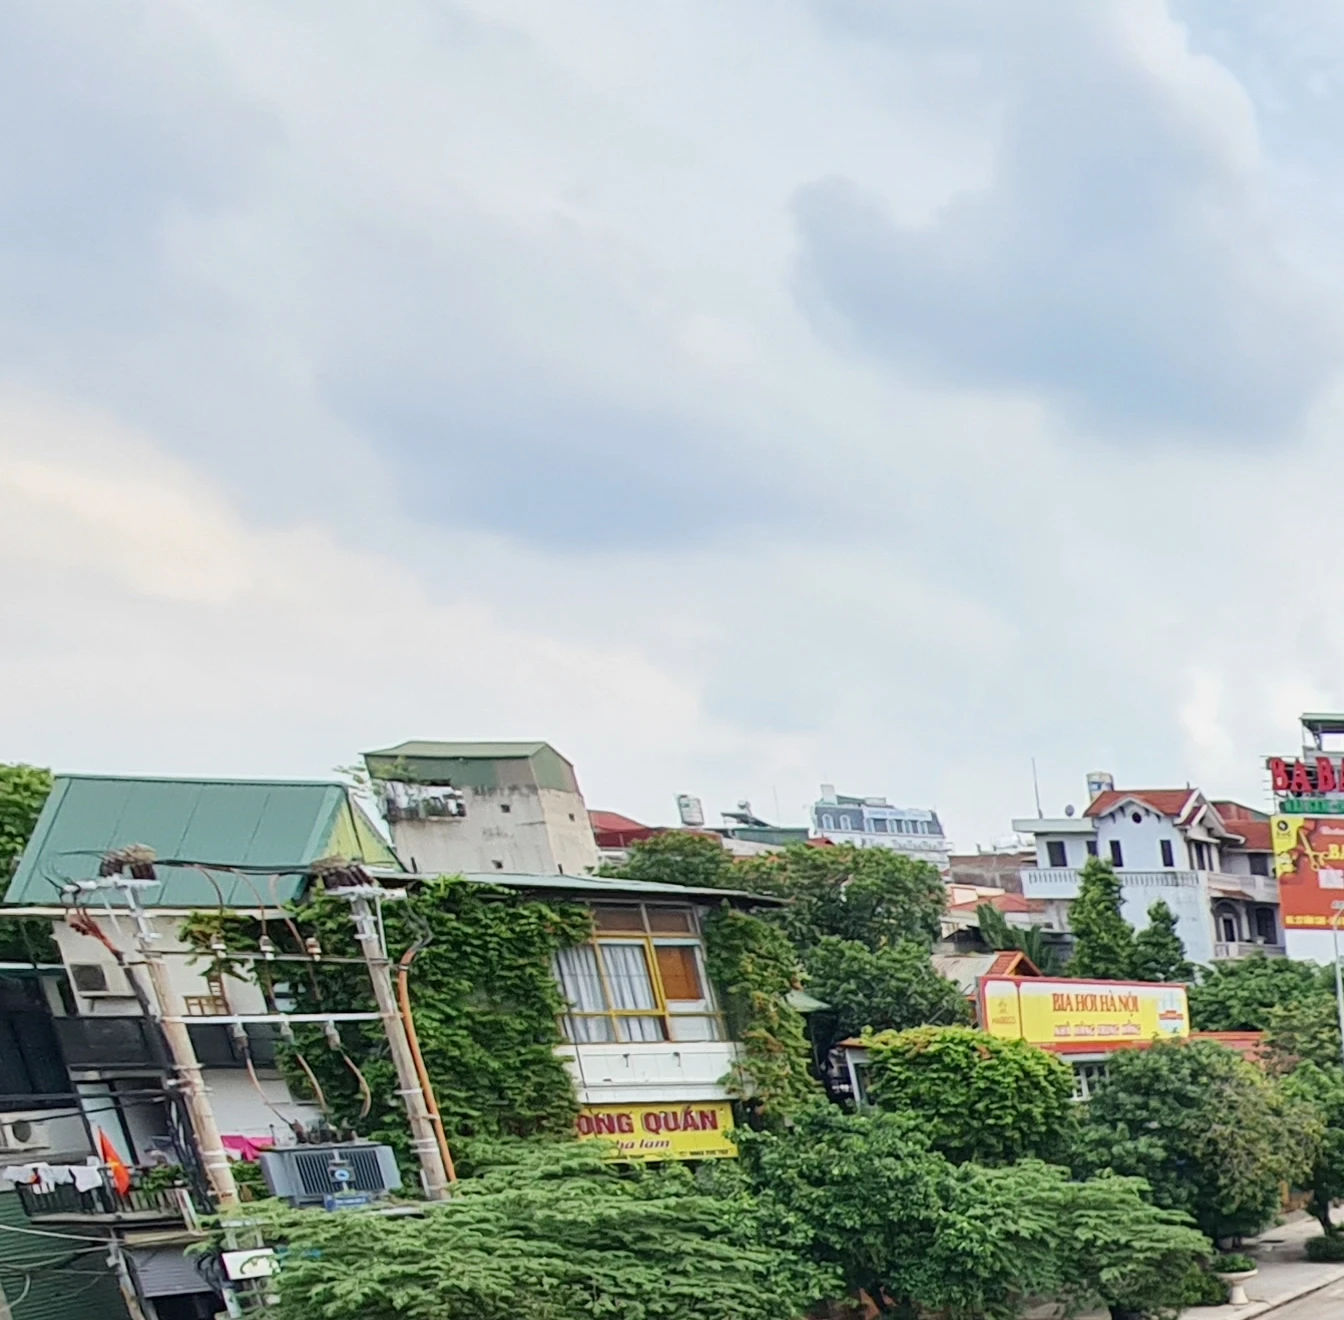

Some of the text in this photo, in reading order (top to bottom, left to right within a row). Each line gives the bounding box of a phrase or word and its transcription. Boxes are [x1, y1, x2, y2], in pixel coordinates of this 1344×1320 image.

[1052, 993, 1073, 1012] BIA
[1100, 990, 1118, 1012] HÀ
[642, 1103, 719, 1134] QUÁN
